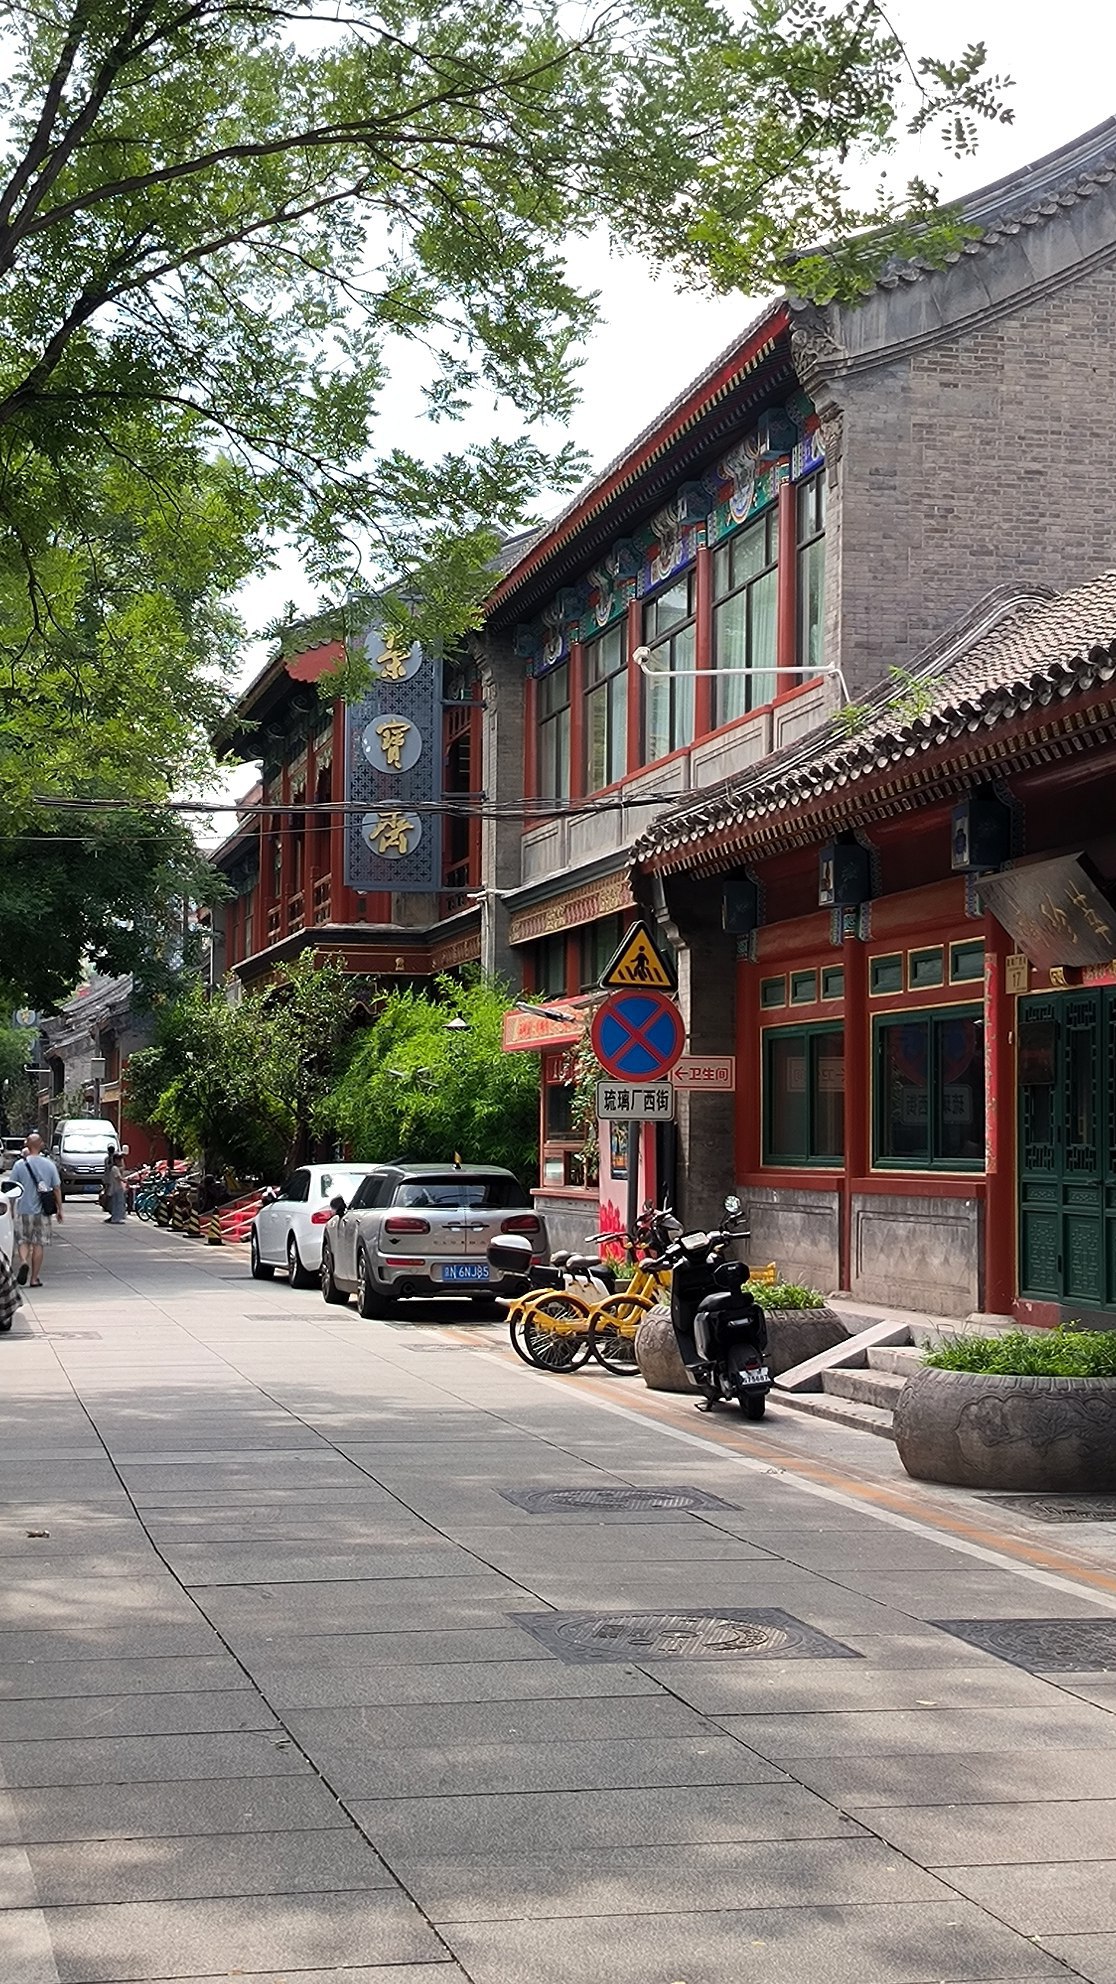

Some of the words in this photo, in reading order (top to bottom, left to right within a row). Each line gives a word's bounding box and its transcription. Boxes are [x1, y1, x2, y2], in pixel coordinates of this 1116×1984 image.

[689, 1067, 729, 1081] 卫生间
[604, 1089, 669, 1112] 琉璃厂西街
